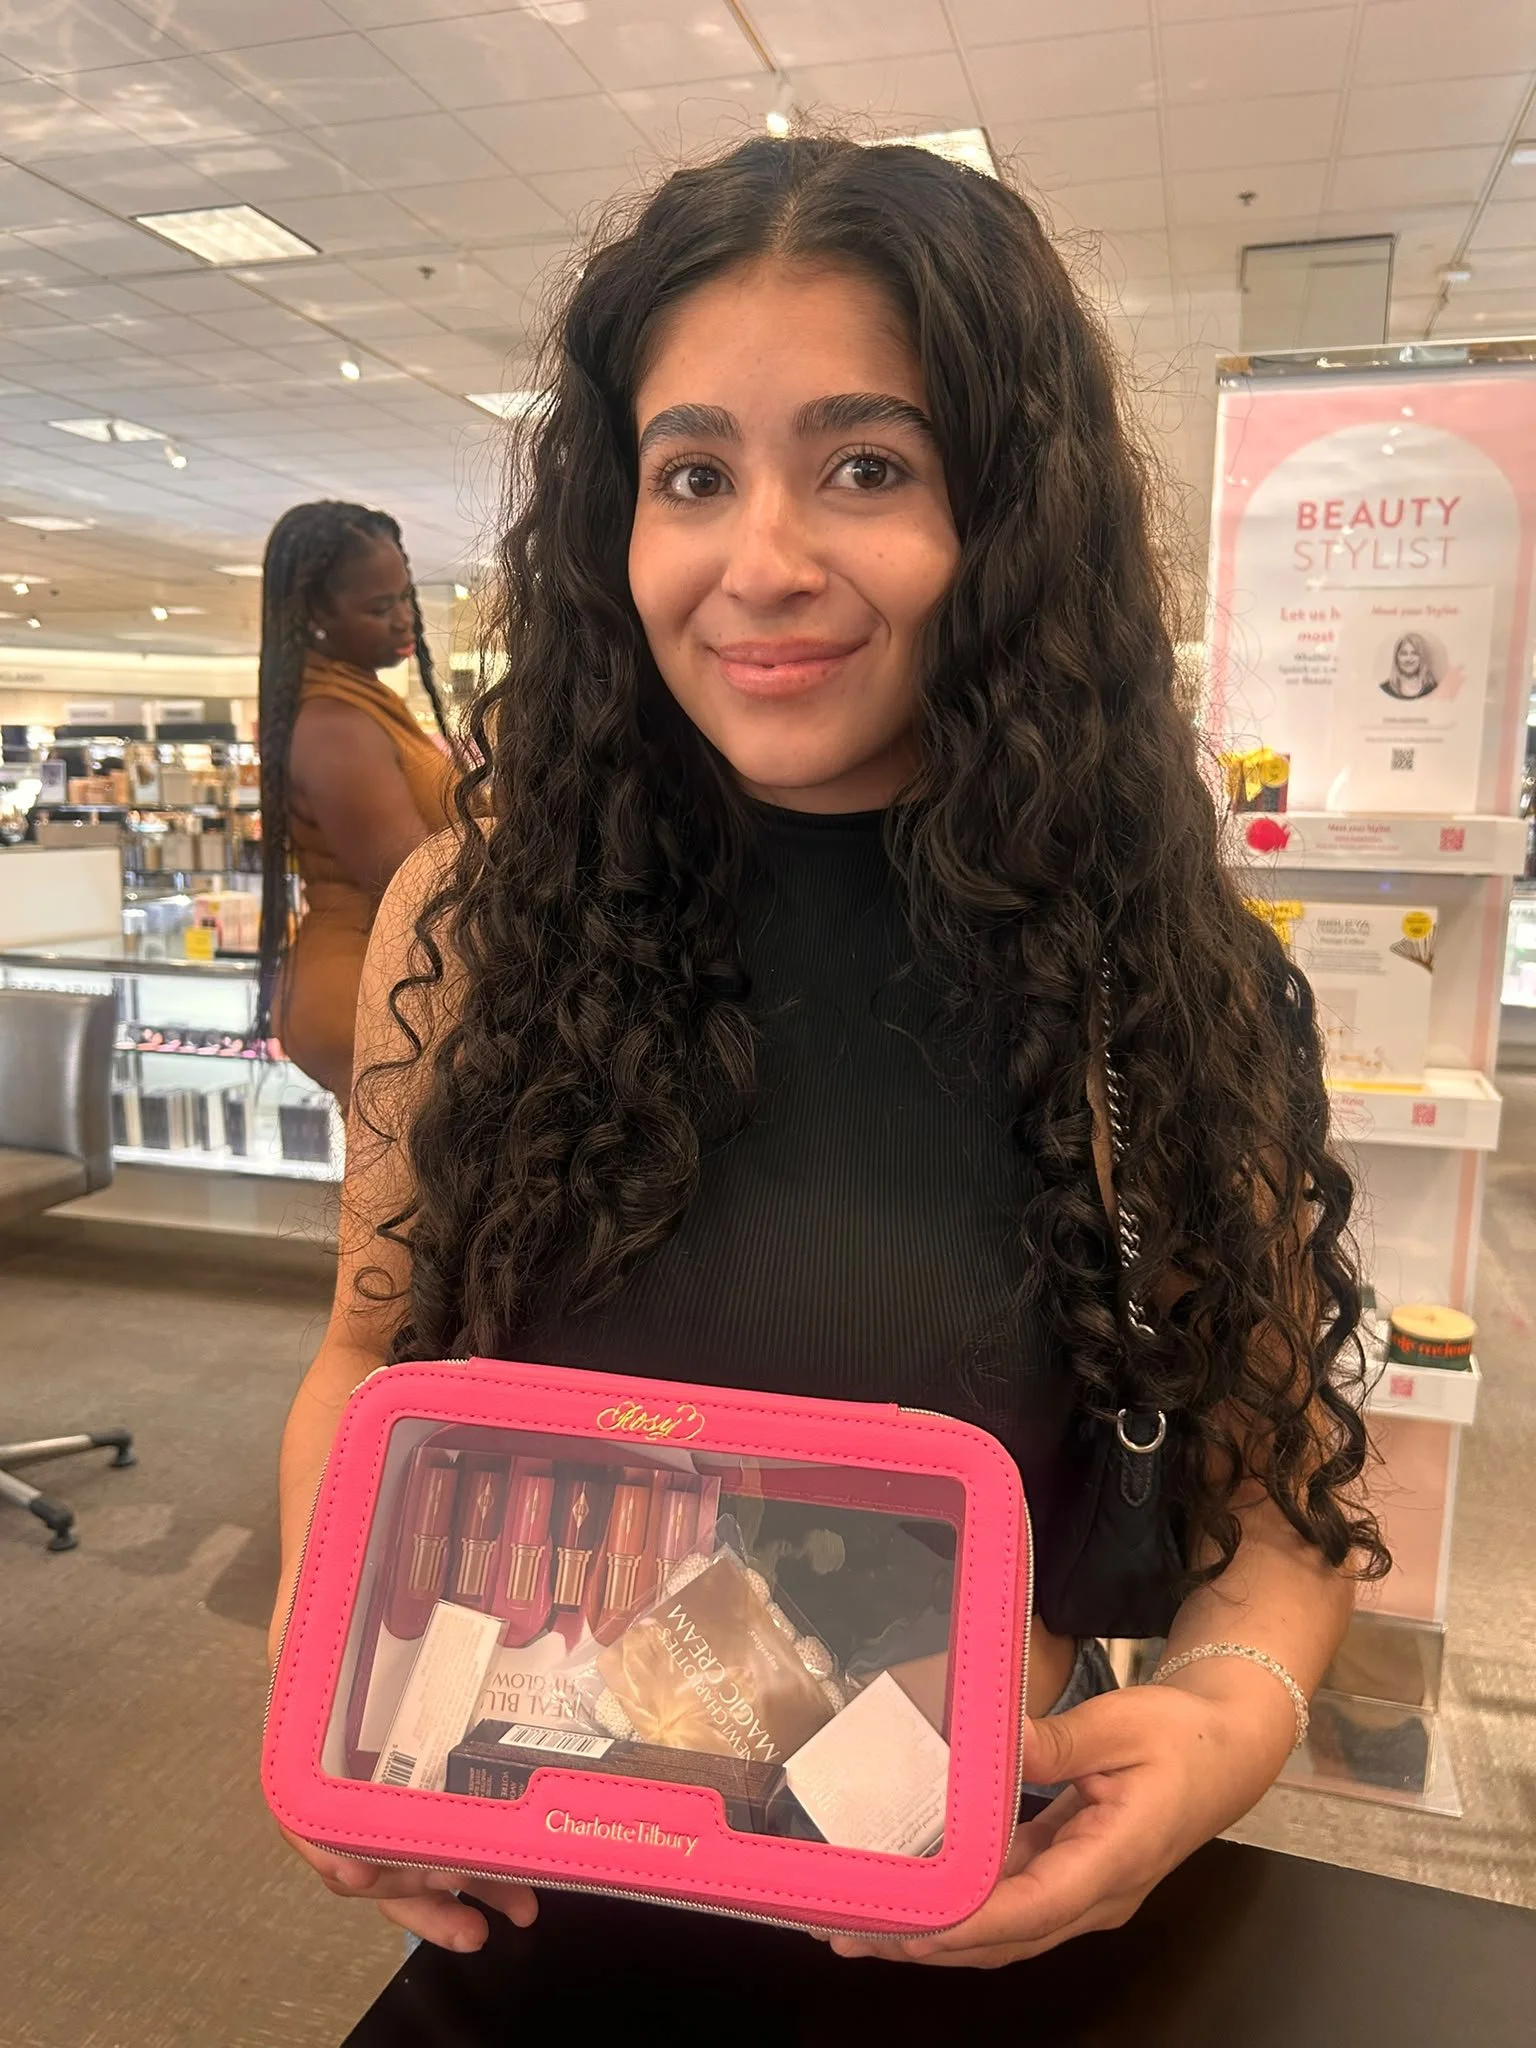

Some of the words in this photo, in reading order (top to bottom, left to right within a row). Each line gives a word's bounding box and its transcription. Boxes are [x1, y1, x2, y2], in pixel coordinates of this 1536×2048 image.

[1297, 496, 1462, 531] BEAUTY
[1293, 535, 1458, 572] STYLIST
[597, 1400, 705, 1441] Rosy
[667, 1603, 726, 1685] CREAM
[491, 1671, 546, 1691] GLOW
[718, 1682, 781, 1762] MAGIC
[545, 1807, 637, 1843] Charlotte
[634, 1818, 699, 1858] Tilbury
